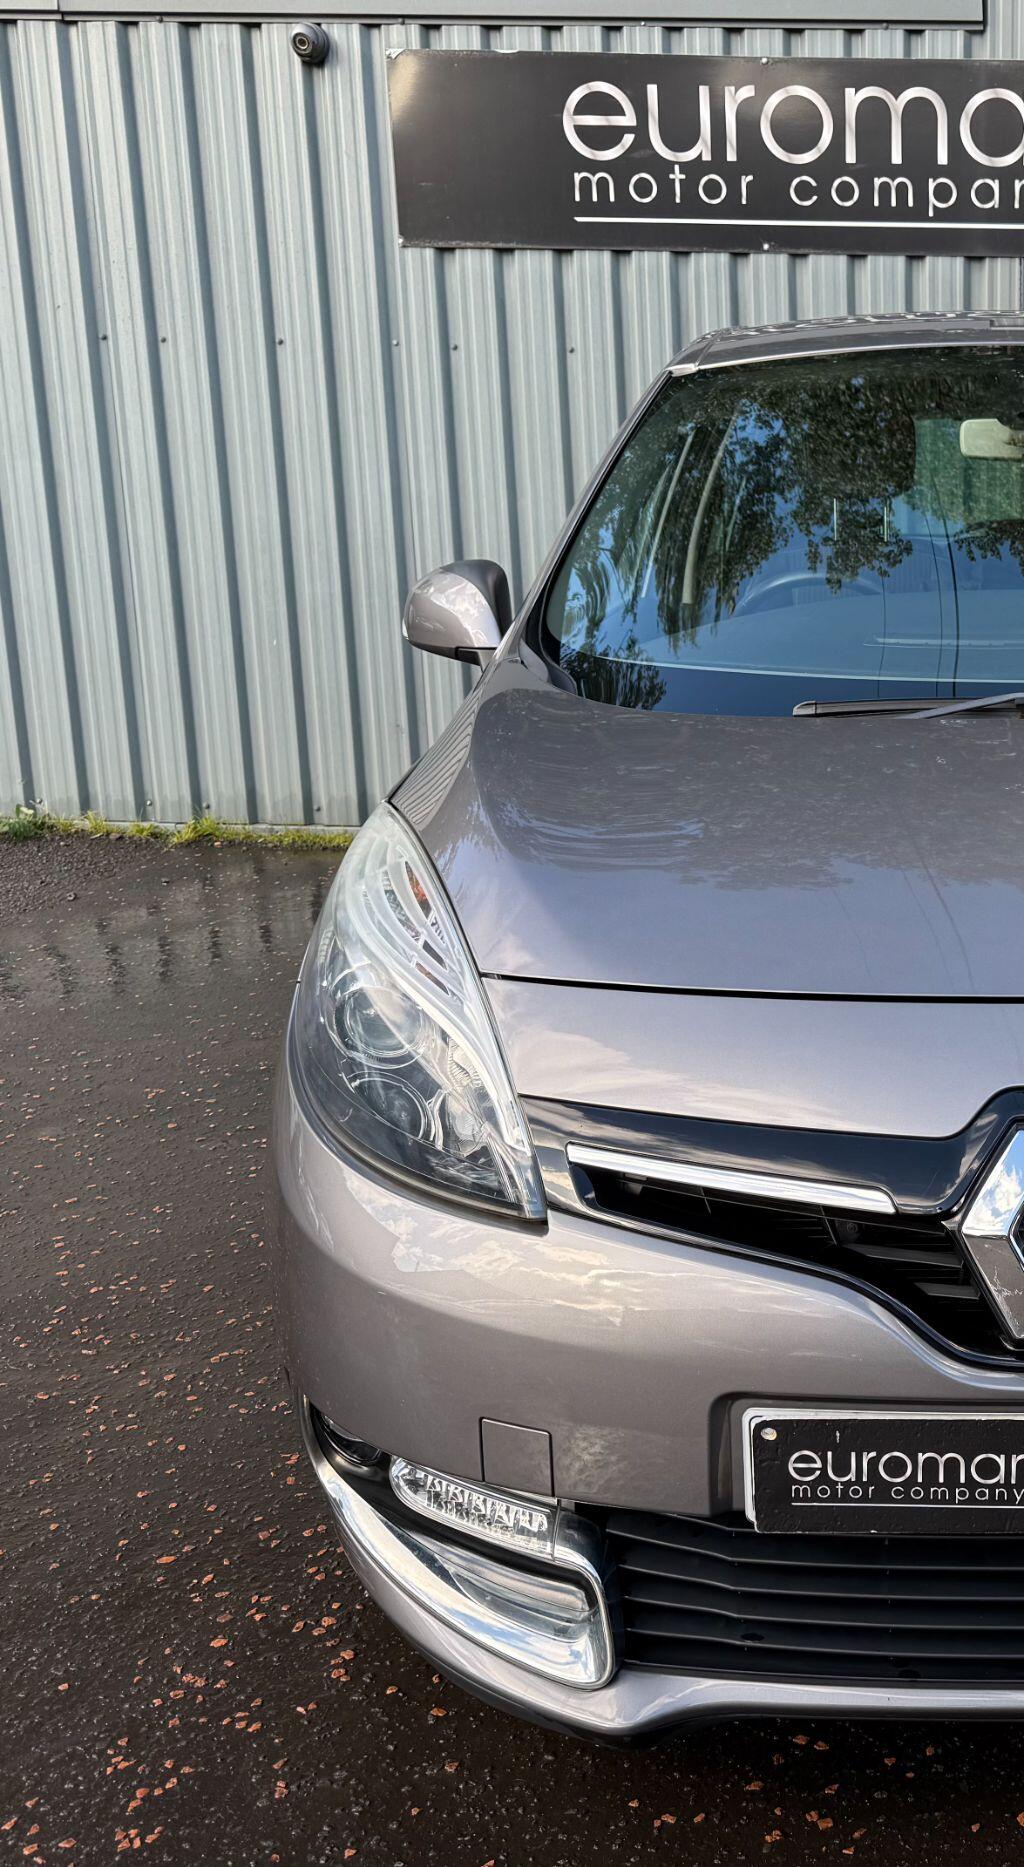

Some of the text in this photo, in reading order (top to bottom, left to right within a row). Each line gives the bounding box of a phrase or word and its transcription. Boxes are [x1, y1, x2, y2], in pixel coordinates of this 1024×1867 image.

[573, 164, 754, 204] motor
[791, 1482, 1024, 1504] motor company
